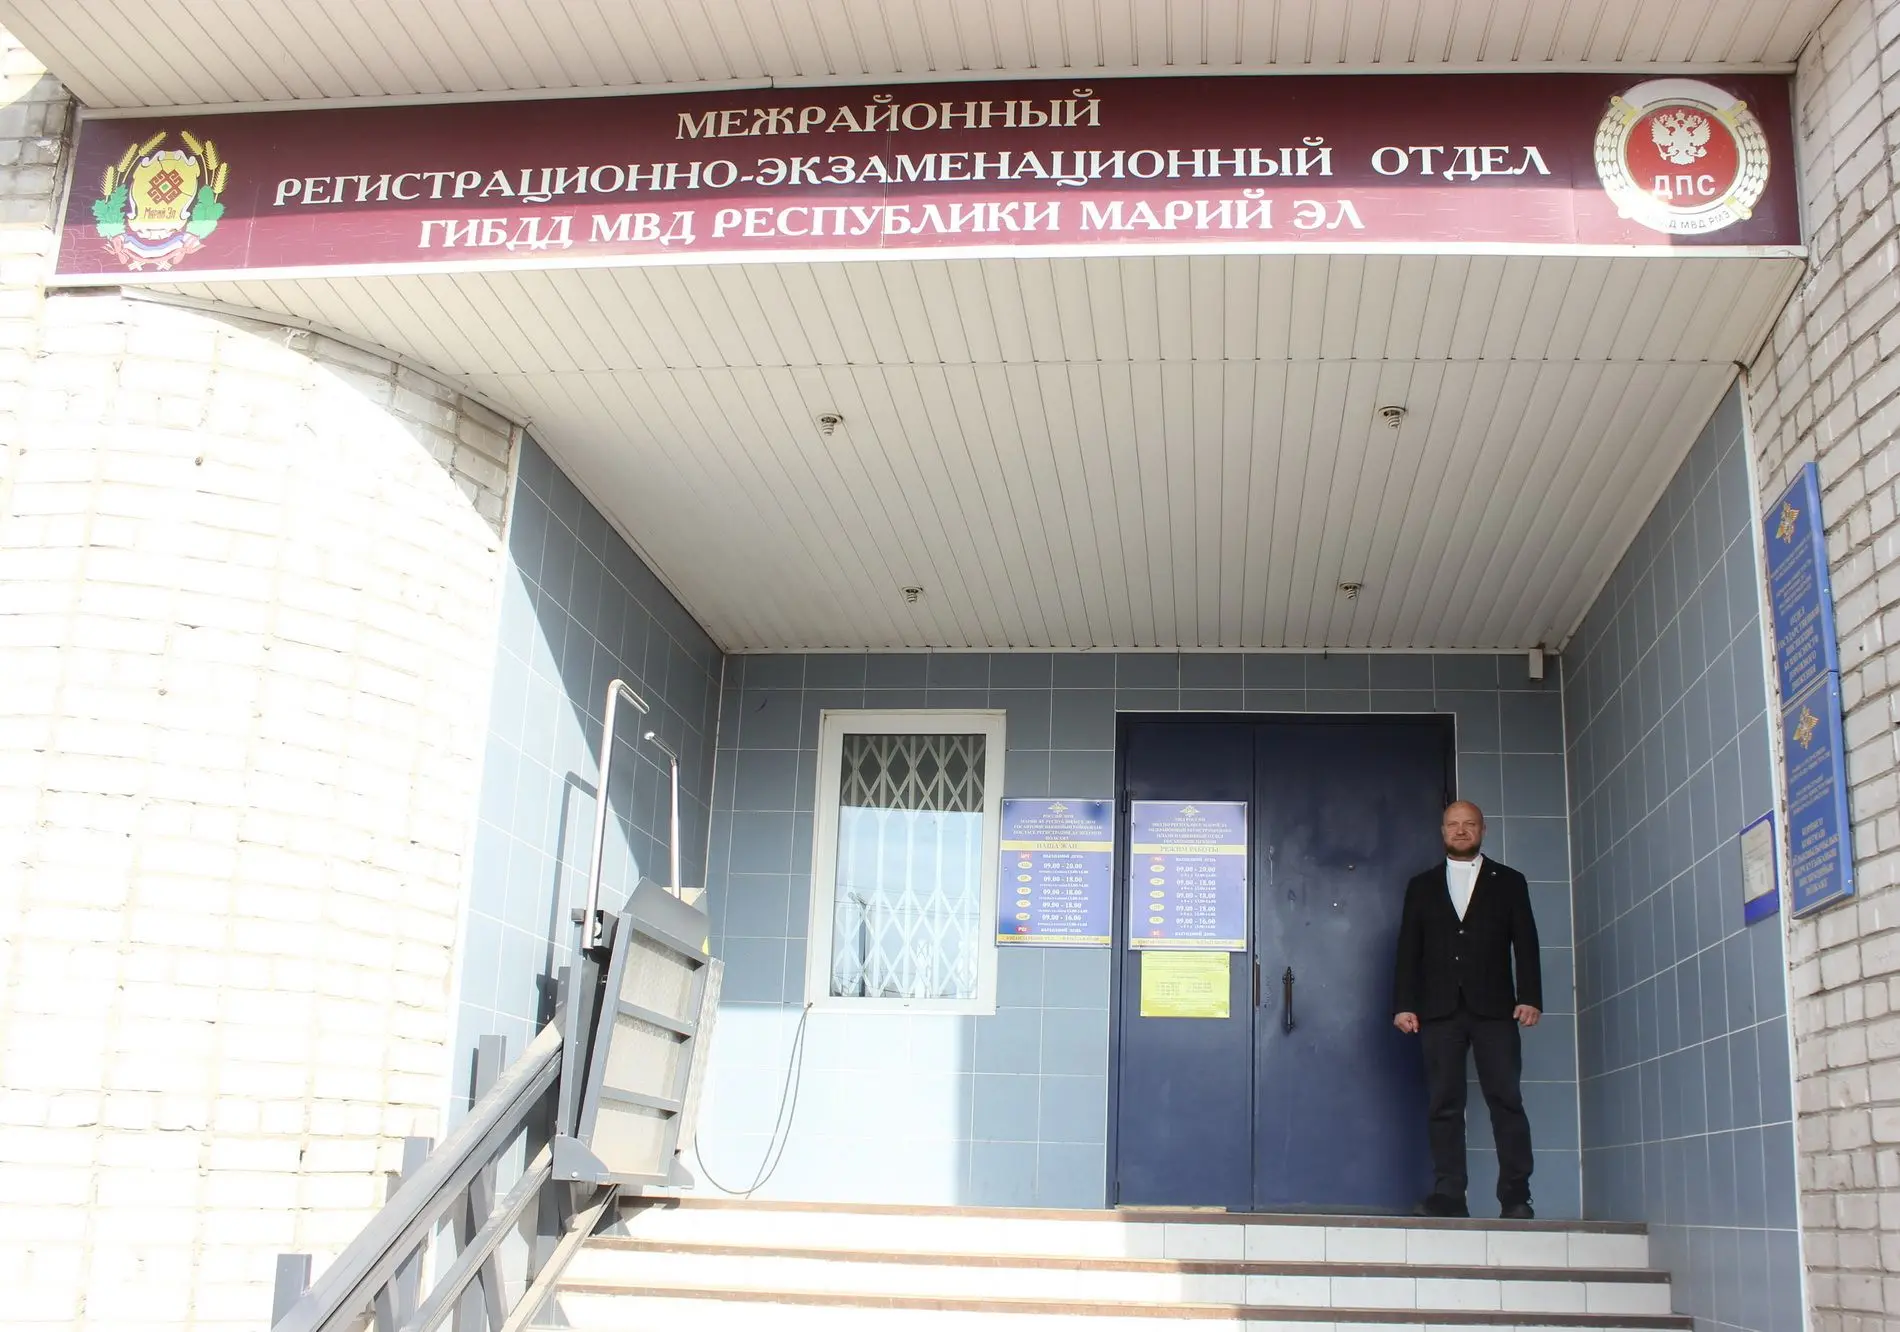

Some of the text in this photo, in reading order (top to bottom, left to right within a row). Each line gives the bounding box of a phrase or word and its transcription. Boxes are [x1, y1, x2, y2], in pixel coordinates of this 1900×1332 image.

[676, 88, 1101, 140] МЕЖРАЙОННЫЙ
[273, 137, 1551, 206] РЕГИСТРАЦИОННО-ЭКЗАМЕНАЦИОННЫЙ ОТДЕЛ
[1652, 174, 1716, 200] ДПС
[417, 187, 1366, 252] ГИБДД МВД РЕСПУБЛИКИ МАРИЙ ЭЛ
[1680, 219, 1707, 229] МВД
